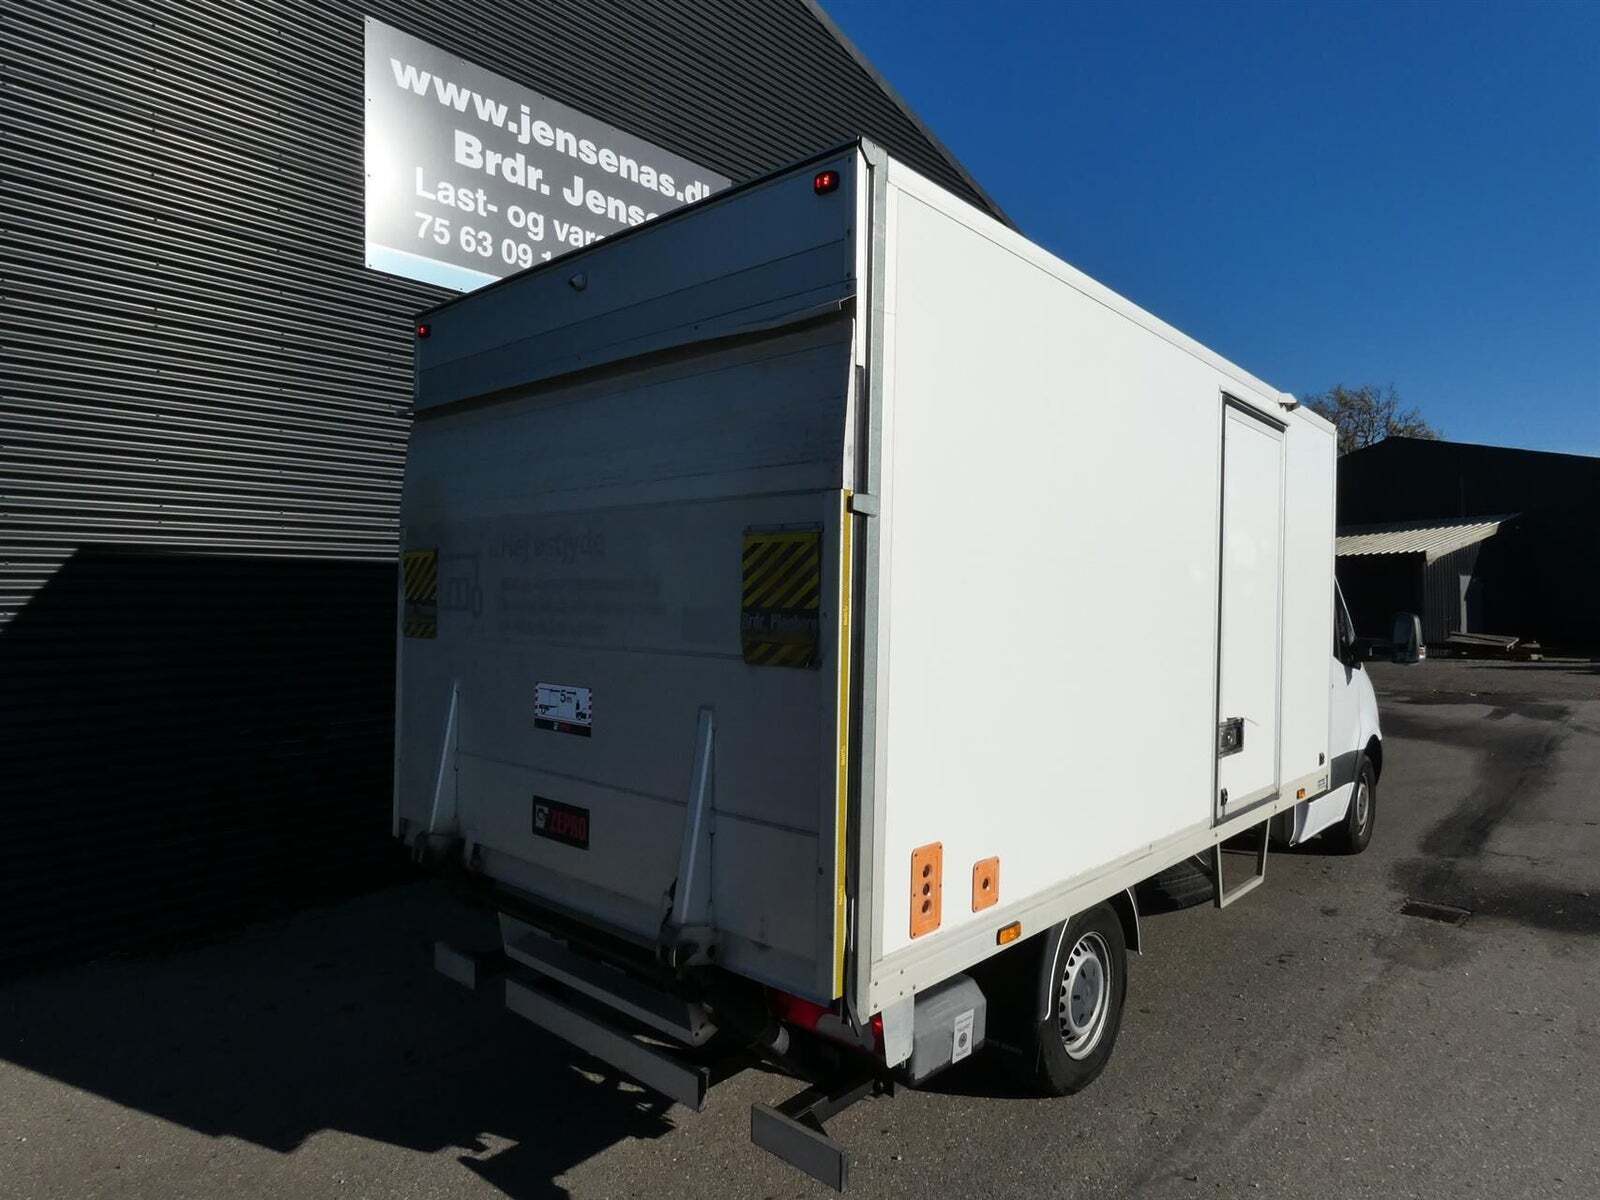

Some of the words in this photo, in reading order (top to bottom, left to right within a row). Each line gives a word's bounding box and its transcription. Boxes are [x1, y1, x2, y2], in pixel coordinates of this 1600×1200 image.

[454, 129, 550, 196] Brdr.
[415, 166, 498, 217] Last-
[506, 204, 545, 242] og
[414, 211, 451, 246] 75
[459, 225, 494, 259] 63
[501, 238, 533, 270] 09
